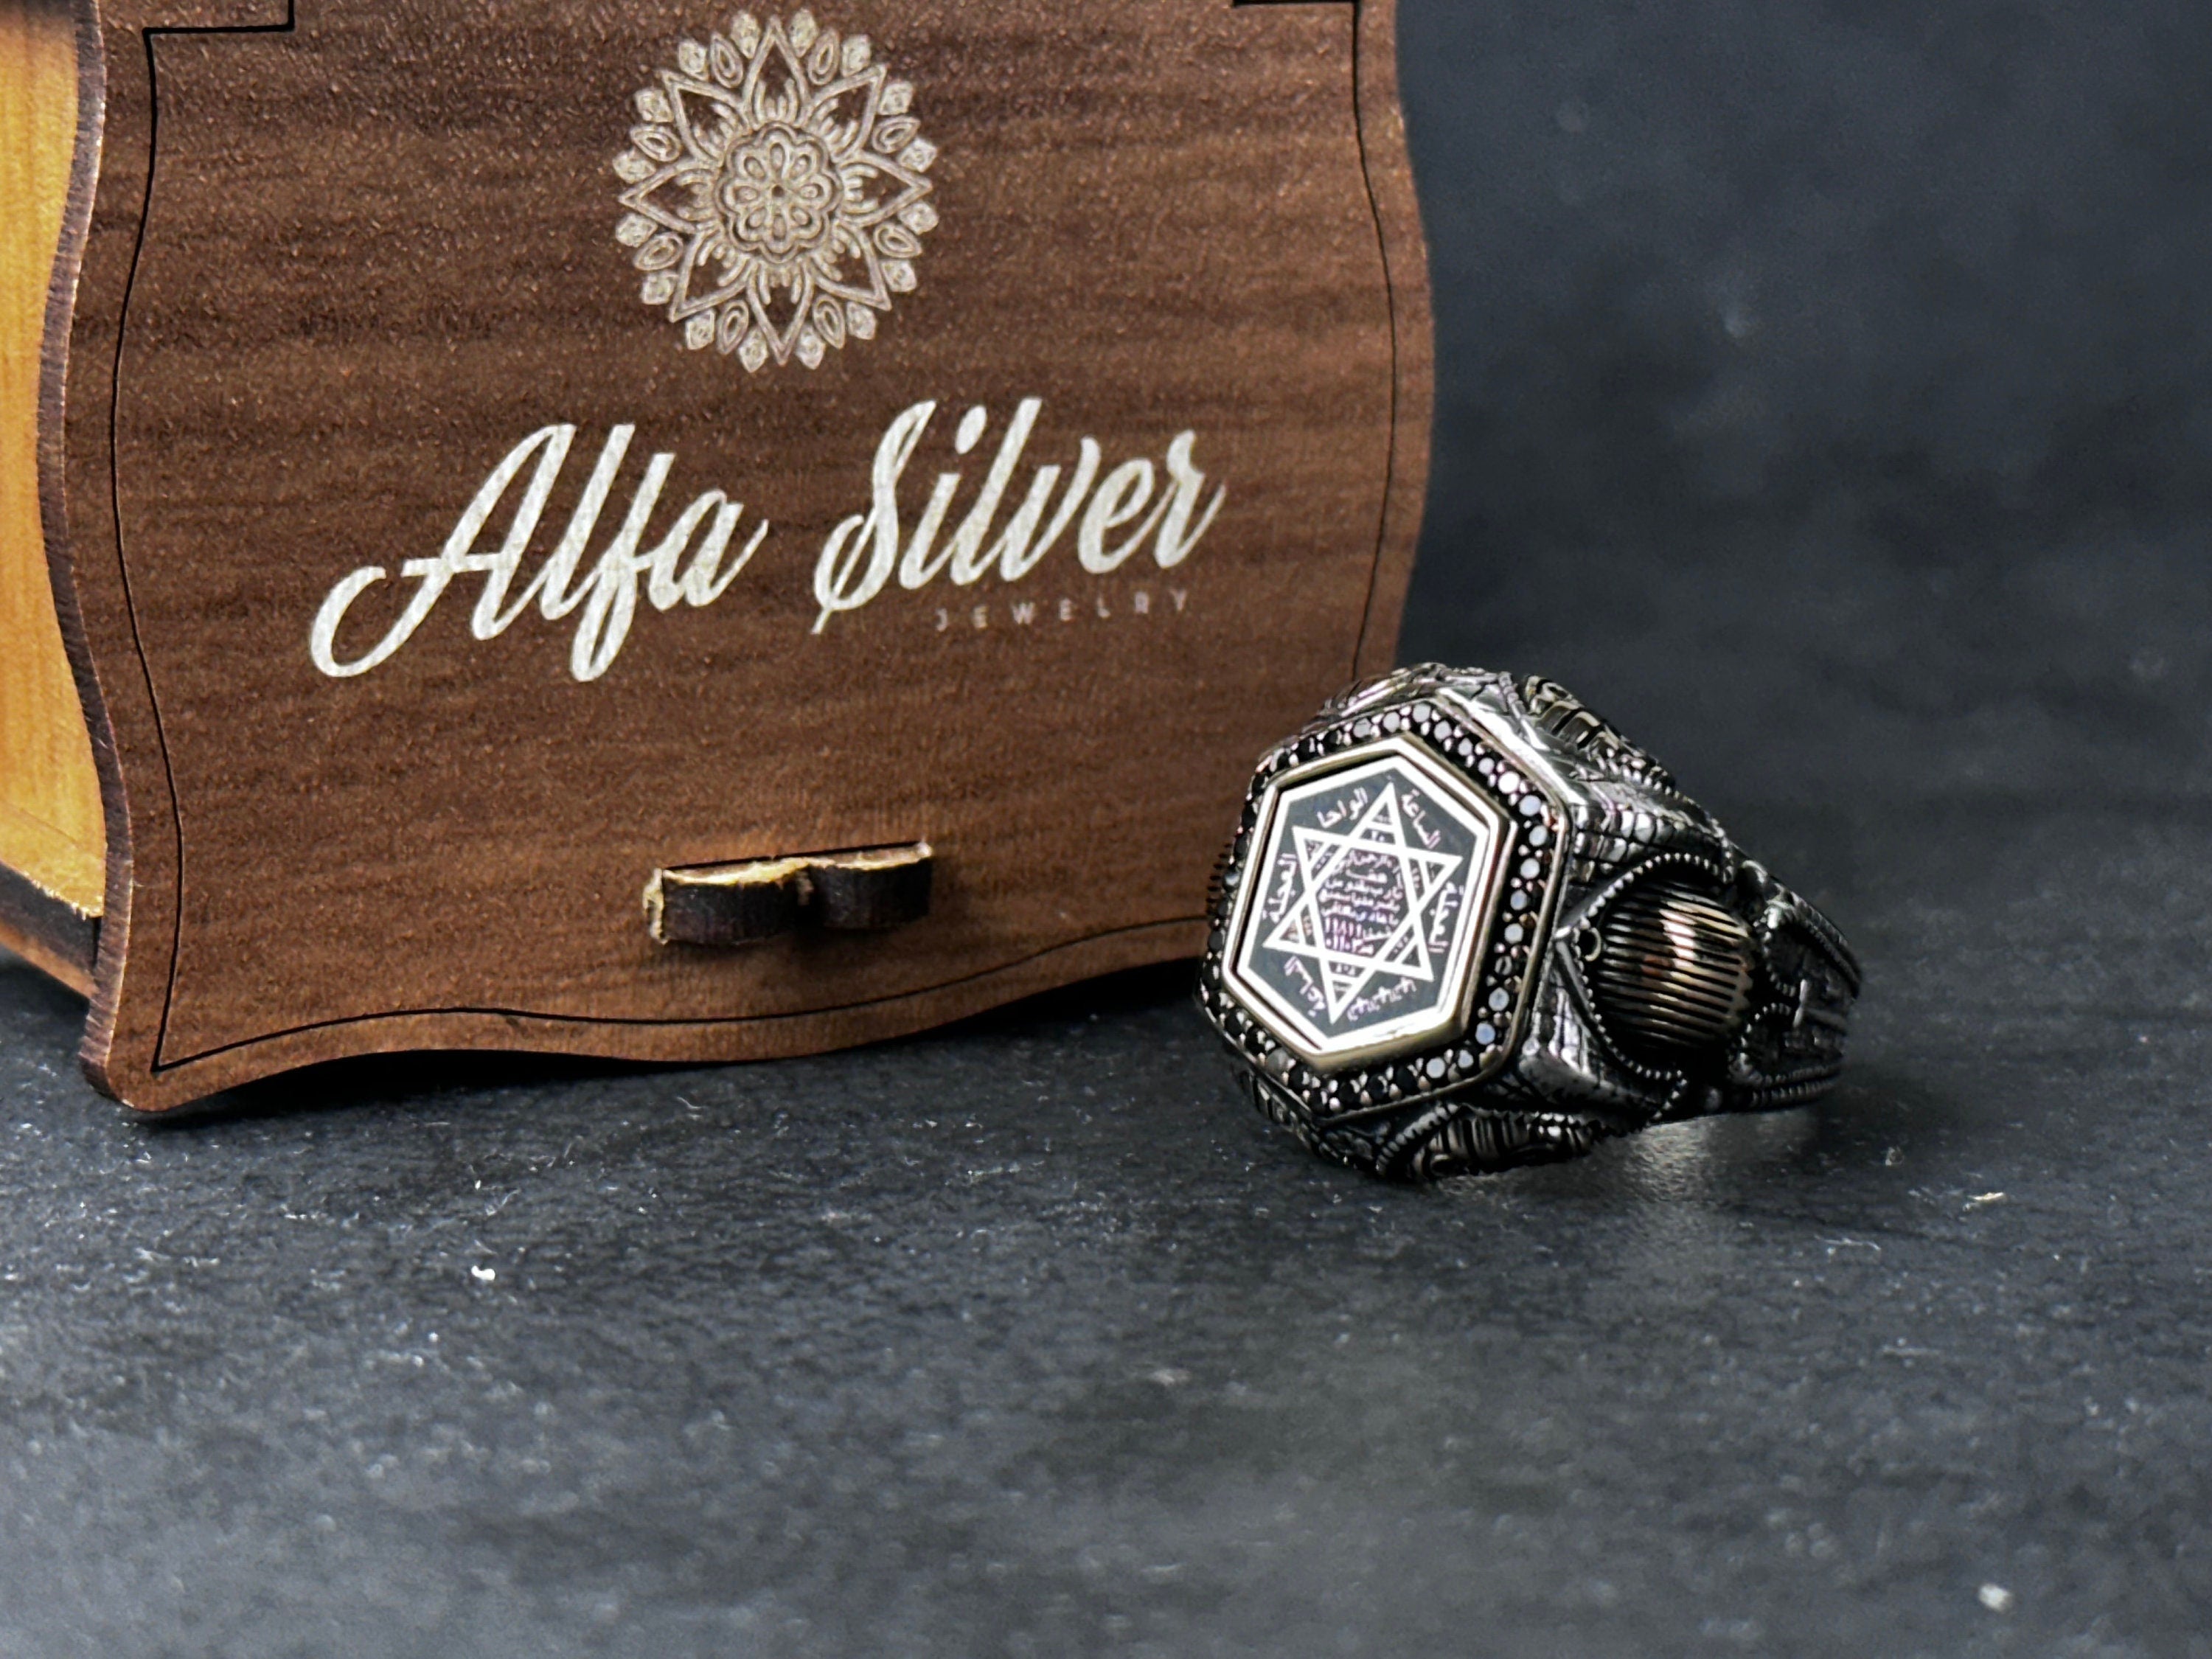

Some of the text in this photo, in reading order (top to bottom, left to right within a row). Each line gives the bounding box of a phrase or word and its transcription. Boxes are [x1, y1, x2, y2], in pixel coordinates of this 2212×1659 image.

[310, 398, 1225, 681] Alfa Silver
[936, 591, 1188, 632] JEWELRY
